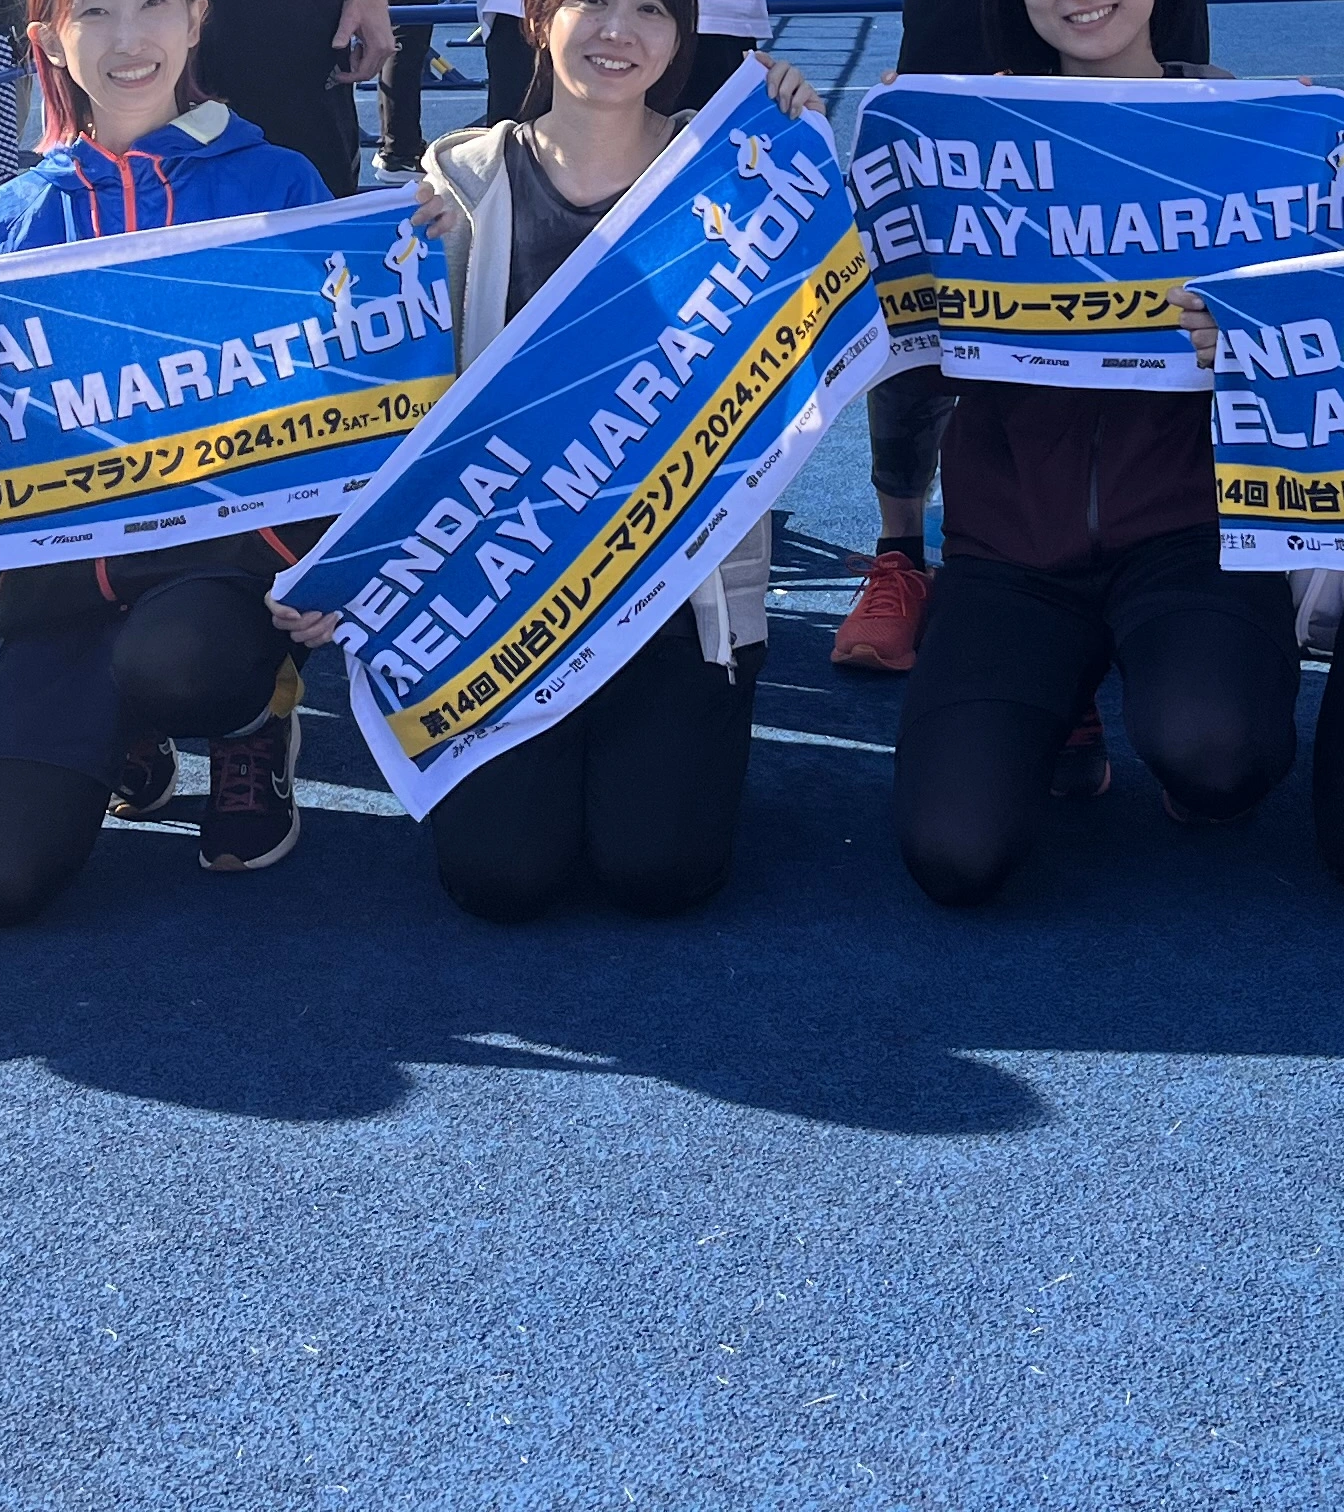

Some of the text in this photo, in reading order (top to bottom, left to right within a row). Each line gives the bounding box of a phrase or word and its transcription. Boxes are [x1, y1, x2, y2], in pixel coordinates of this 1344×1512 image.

[879, 285, 1169, 321] 14回 台リレーマラソン
[51, 277, 454, 432] MARATHON
[890, 334, 940, 356] やぎ生協
[941, 345, 980, 360] 一地所
[370, 150, 831, 696] RELAY MARATHON
[231, 501, 264, 514] BLOOM
[1217, 479, 1268, 507] 14回
[419, 671, 500, 738] 第14回
[490, 455, 697, 684] 仙台リレーマラソン
[549, 646, 595, 693] 山一地所
